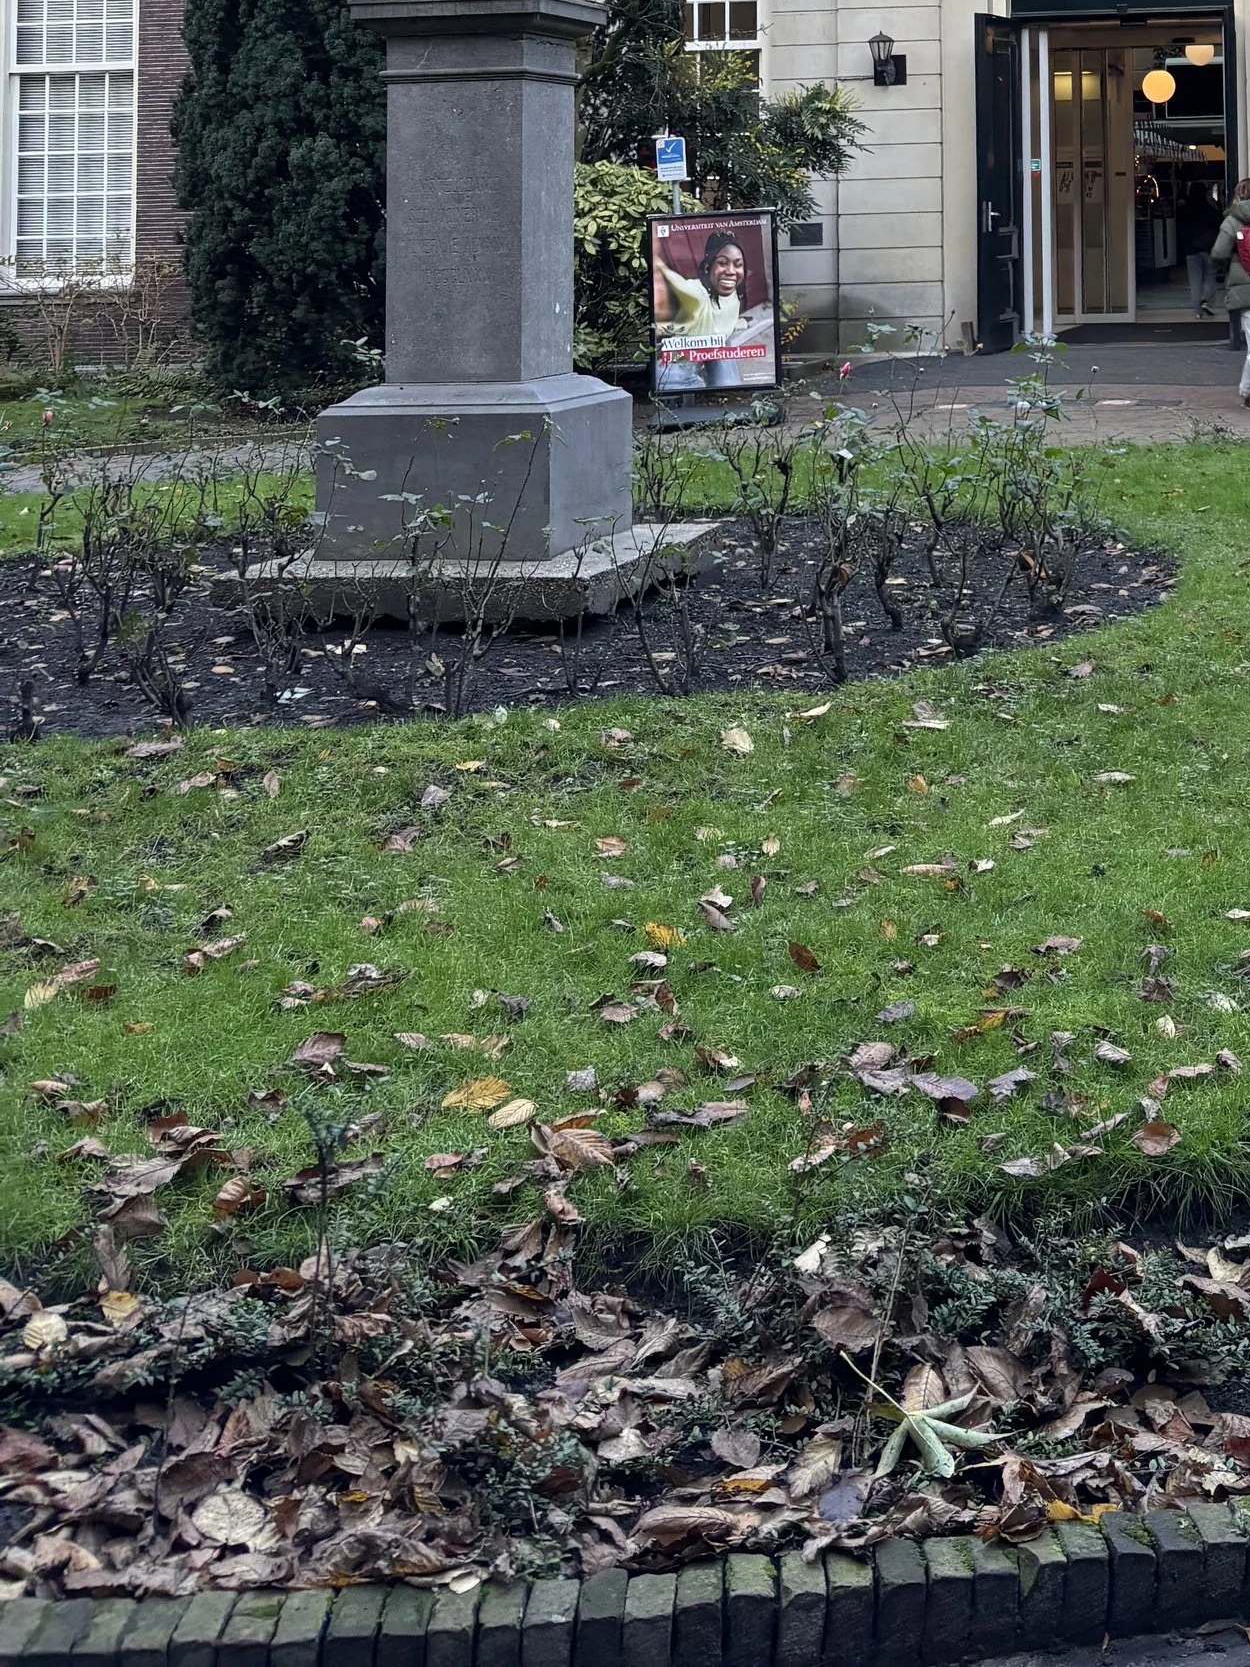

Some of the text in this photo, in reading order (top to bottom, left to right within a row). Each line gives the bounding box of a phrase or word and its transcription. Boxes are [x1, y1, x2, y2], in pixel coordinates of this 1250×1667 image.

[663, 336, 724, 349] Welkom bij
[689, 347, 765, 362] Proefstuderen
